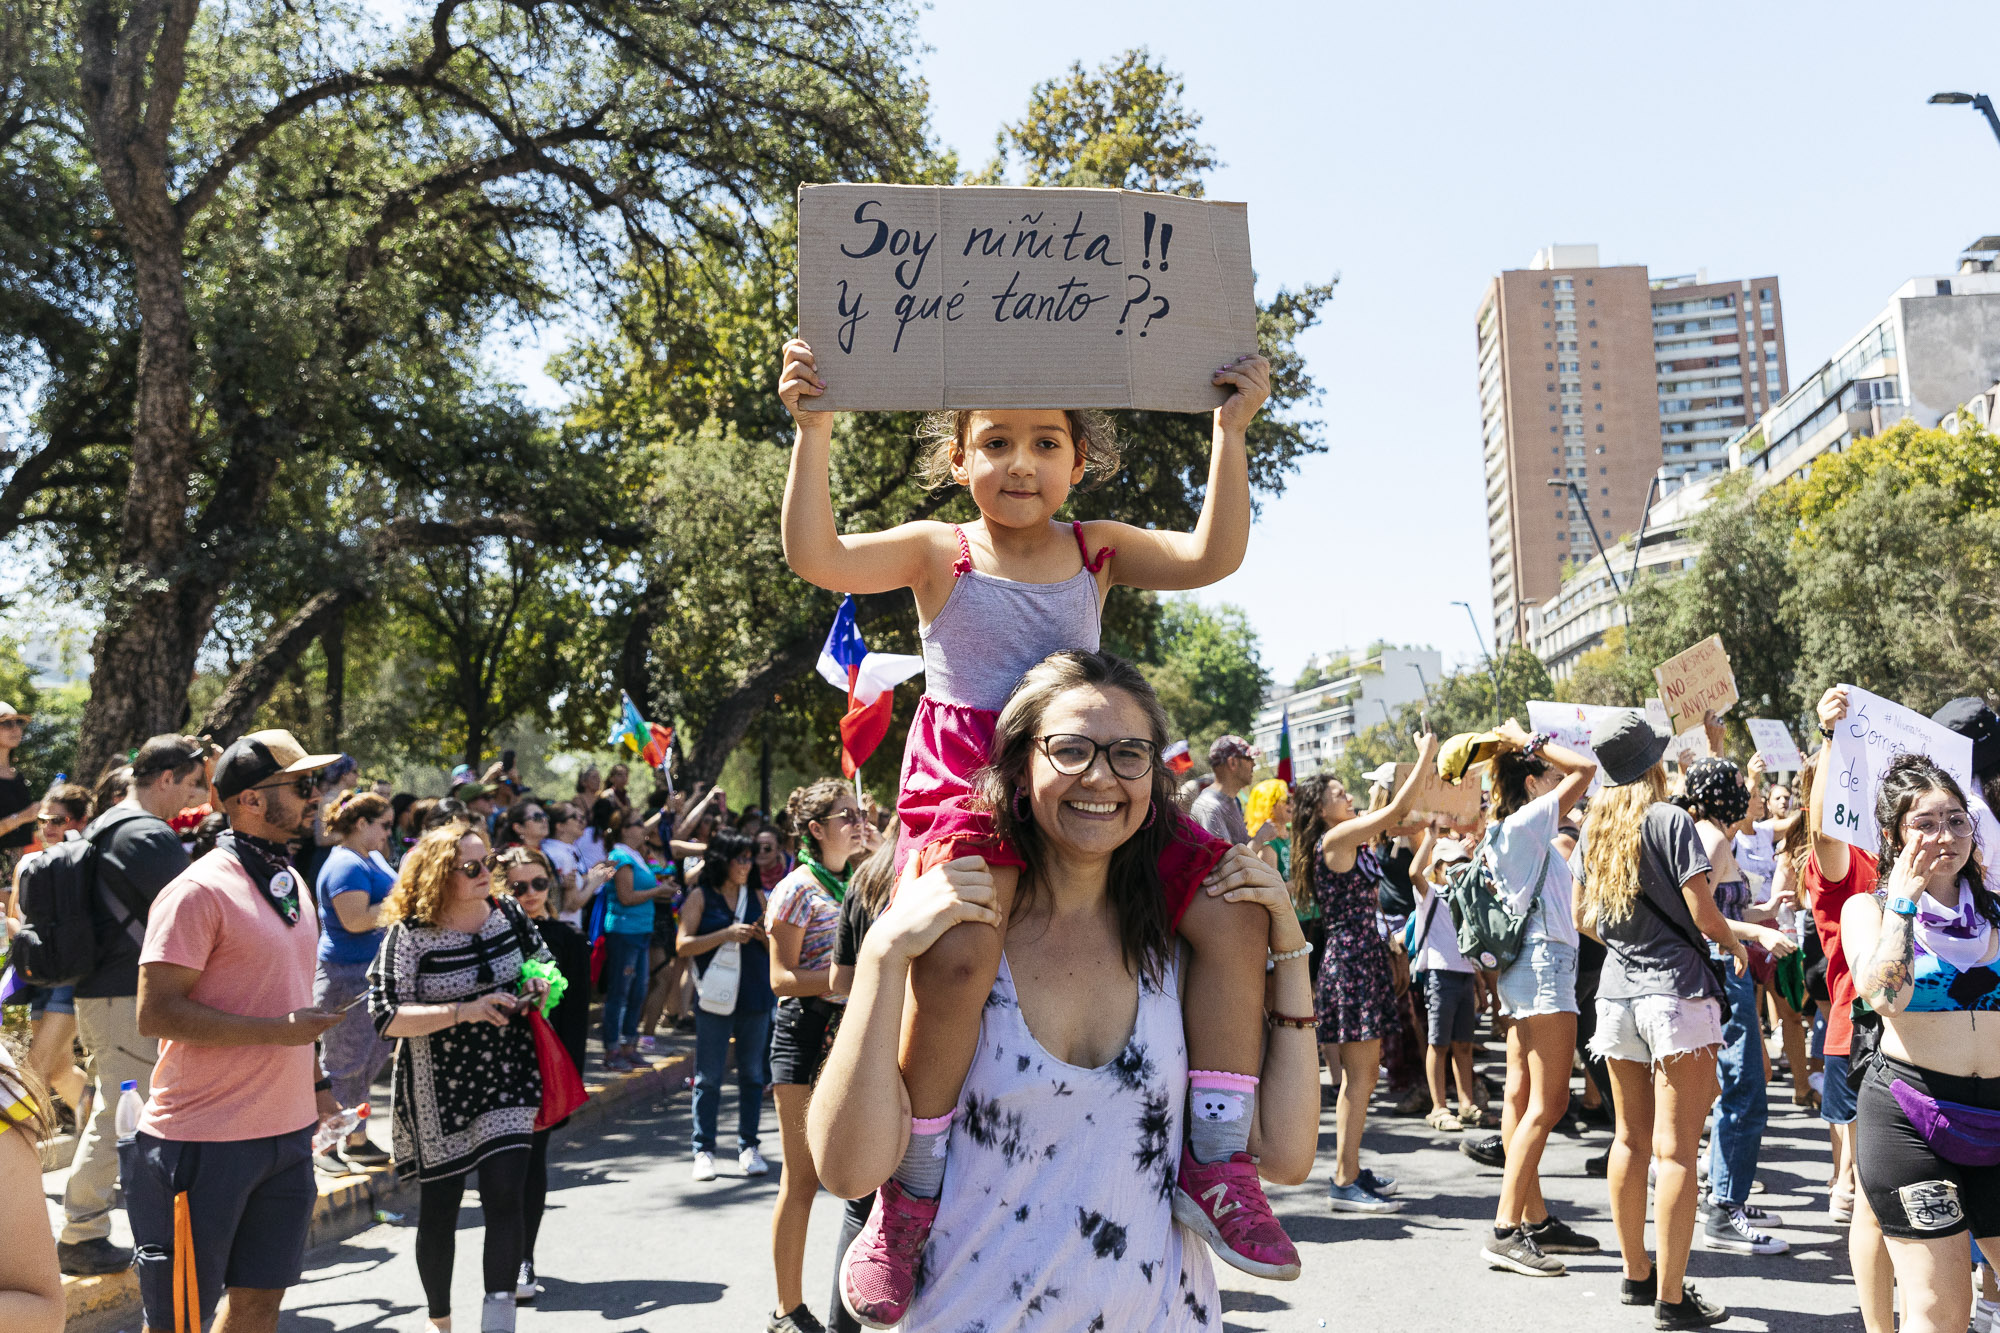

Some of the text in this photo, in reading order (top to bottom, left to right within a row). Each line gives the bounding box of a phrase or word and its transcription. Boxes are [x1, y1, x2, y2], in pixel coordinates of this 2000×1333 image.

[840, 200, 1173, 290] Soy niñita !!
[893, 280, 970, 353] qué
[992, 270, 1109, 323] tanto
[1115, 274, 1170, 338] ??
[1666, 678, 1685, 702] NO
[1839, 757, 1859, 792] de
[1834, 803, 1860, 831] 8M
